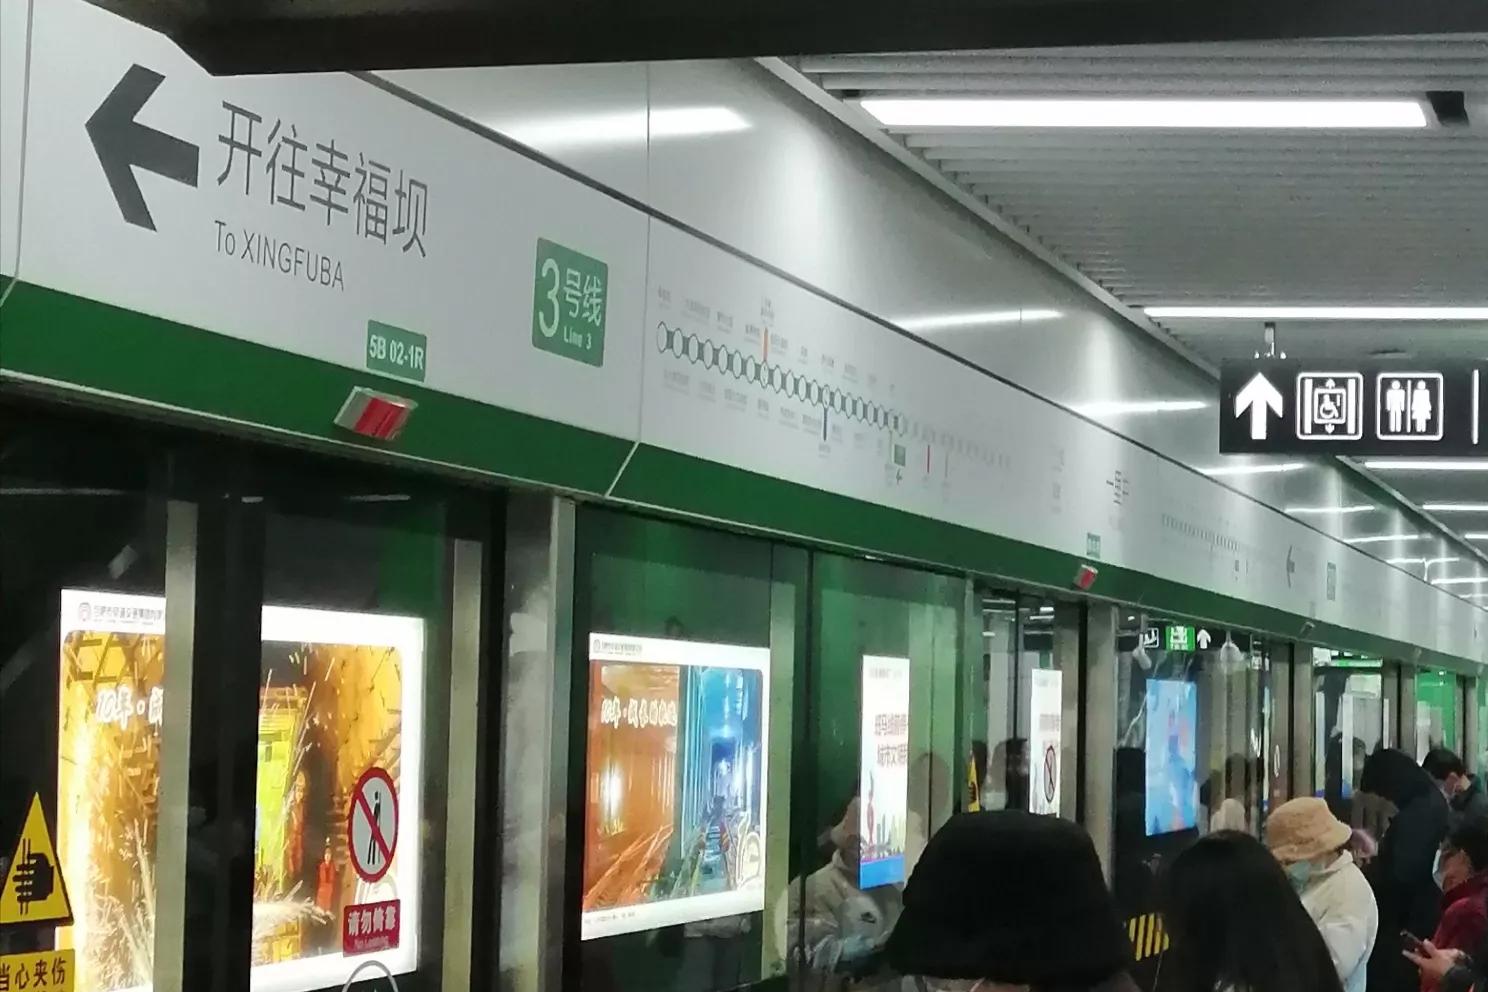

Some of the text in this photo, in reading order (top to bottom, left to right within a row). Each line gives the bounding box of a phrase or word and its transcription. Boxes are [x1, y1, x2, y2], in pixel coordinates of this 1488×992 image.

[217, 101, 428, 258] 开往幸福坝
[215, 219, 345, 292] To XINGFUBA
